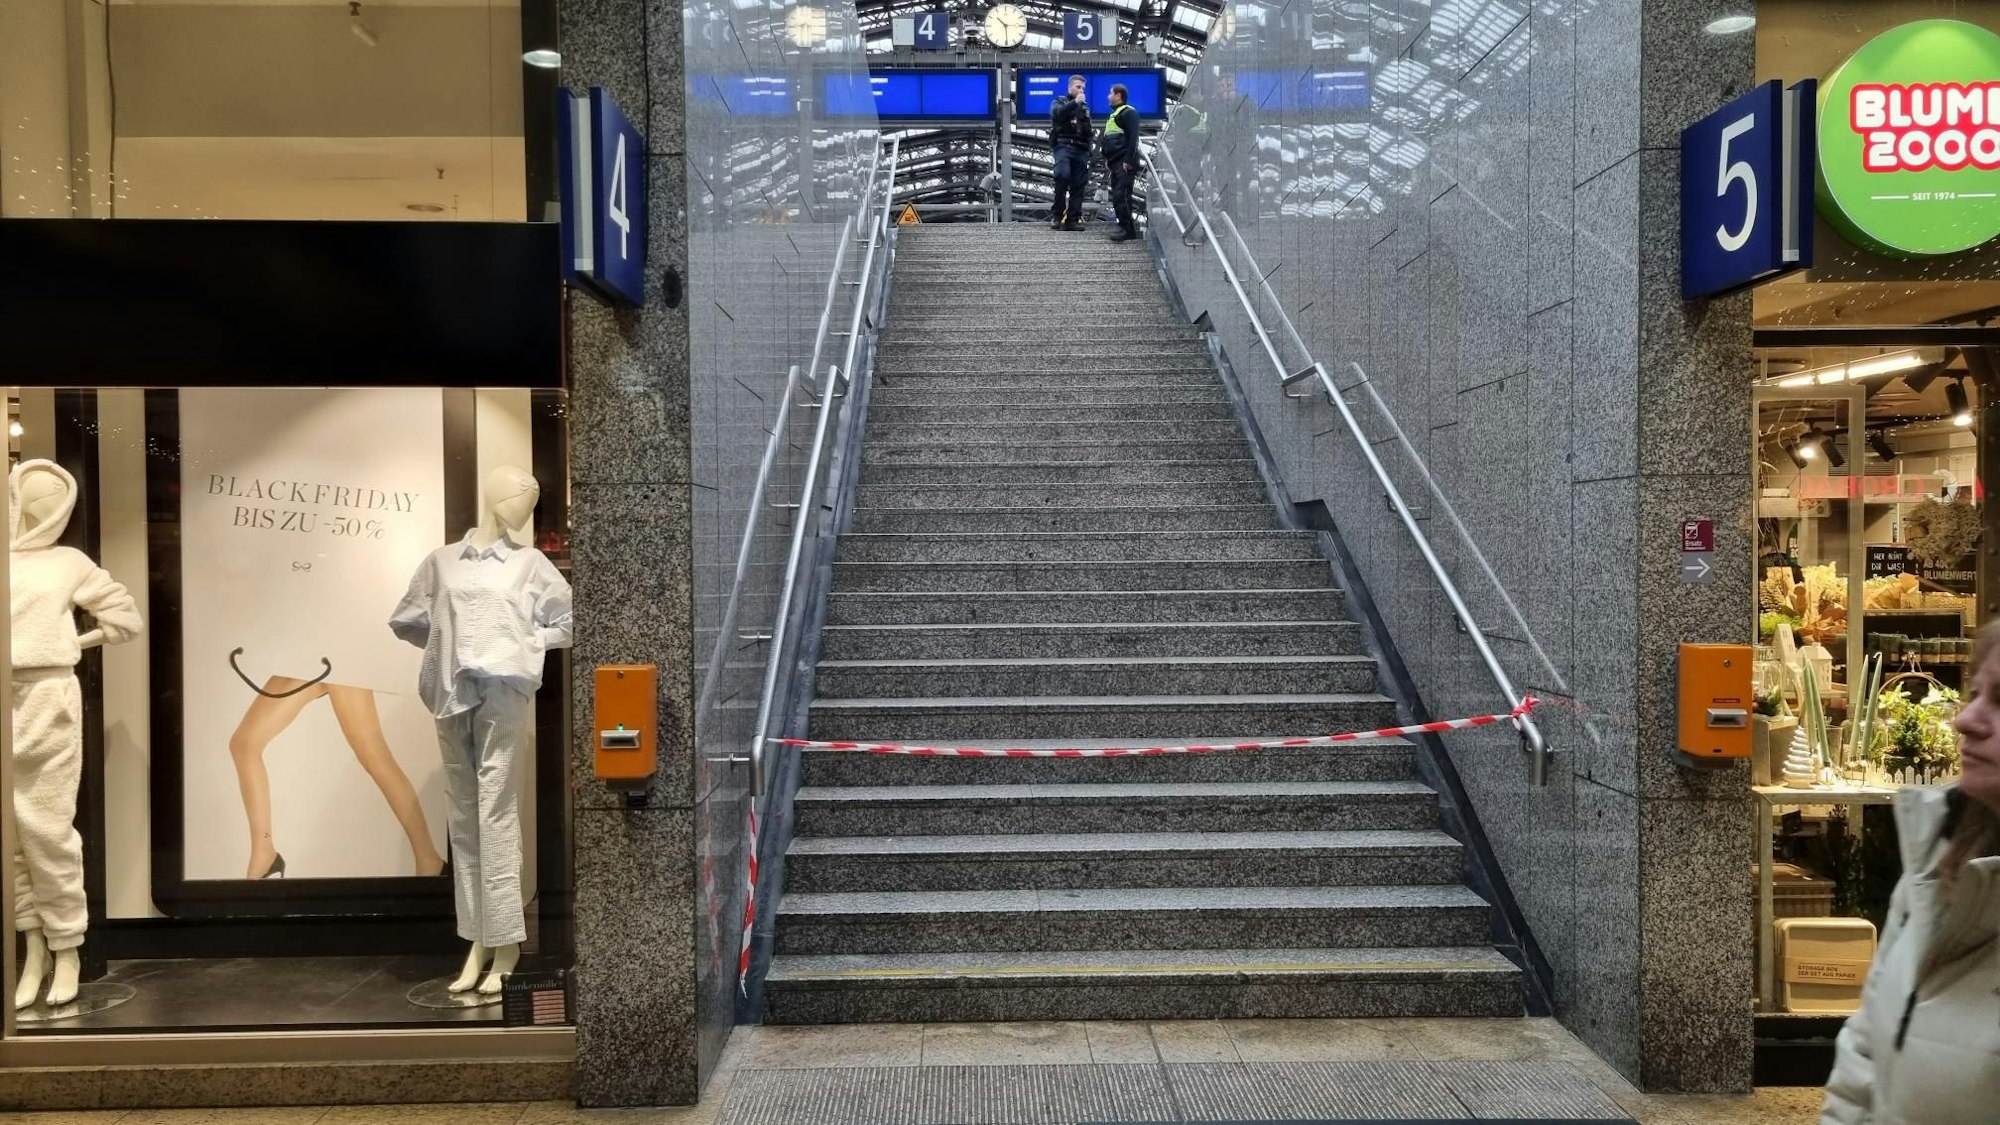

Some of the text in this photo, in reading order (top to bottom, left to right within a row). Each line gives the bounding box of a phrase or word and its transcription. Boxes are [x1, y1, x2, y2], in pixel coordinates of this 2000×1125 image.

[918, 14, 936, 41] 4
[1076, 15, 1094, 41] 5
[1868, 128, 2000, 167] 2000
[1715, 112, 1758, 252] 5
[609, 132, 630, 260] 4
[1912, 192, 1955, 200] SEIT 1974
[232, 506, 276, 529] BIS
[279, 510, 318, 533] ZU
